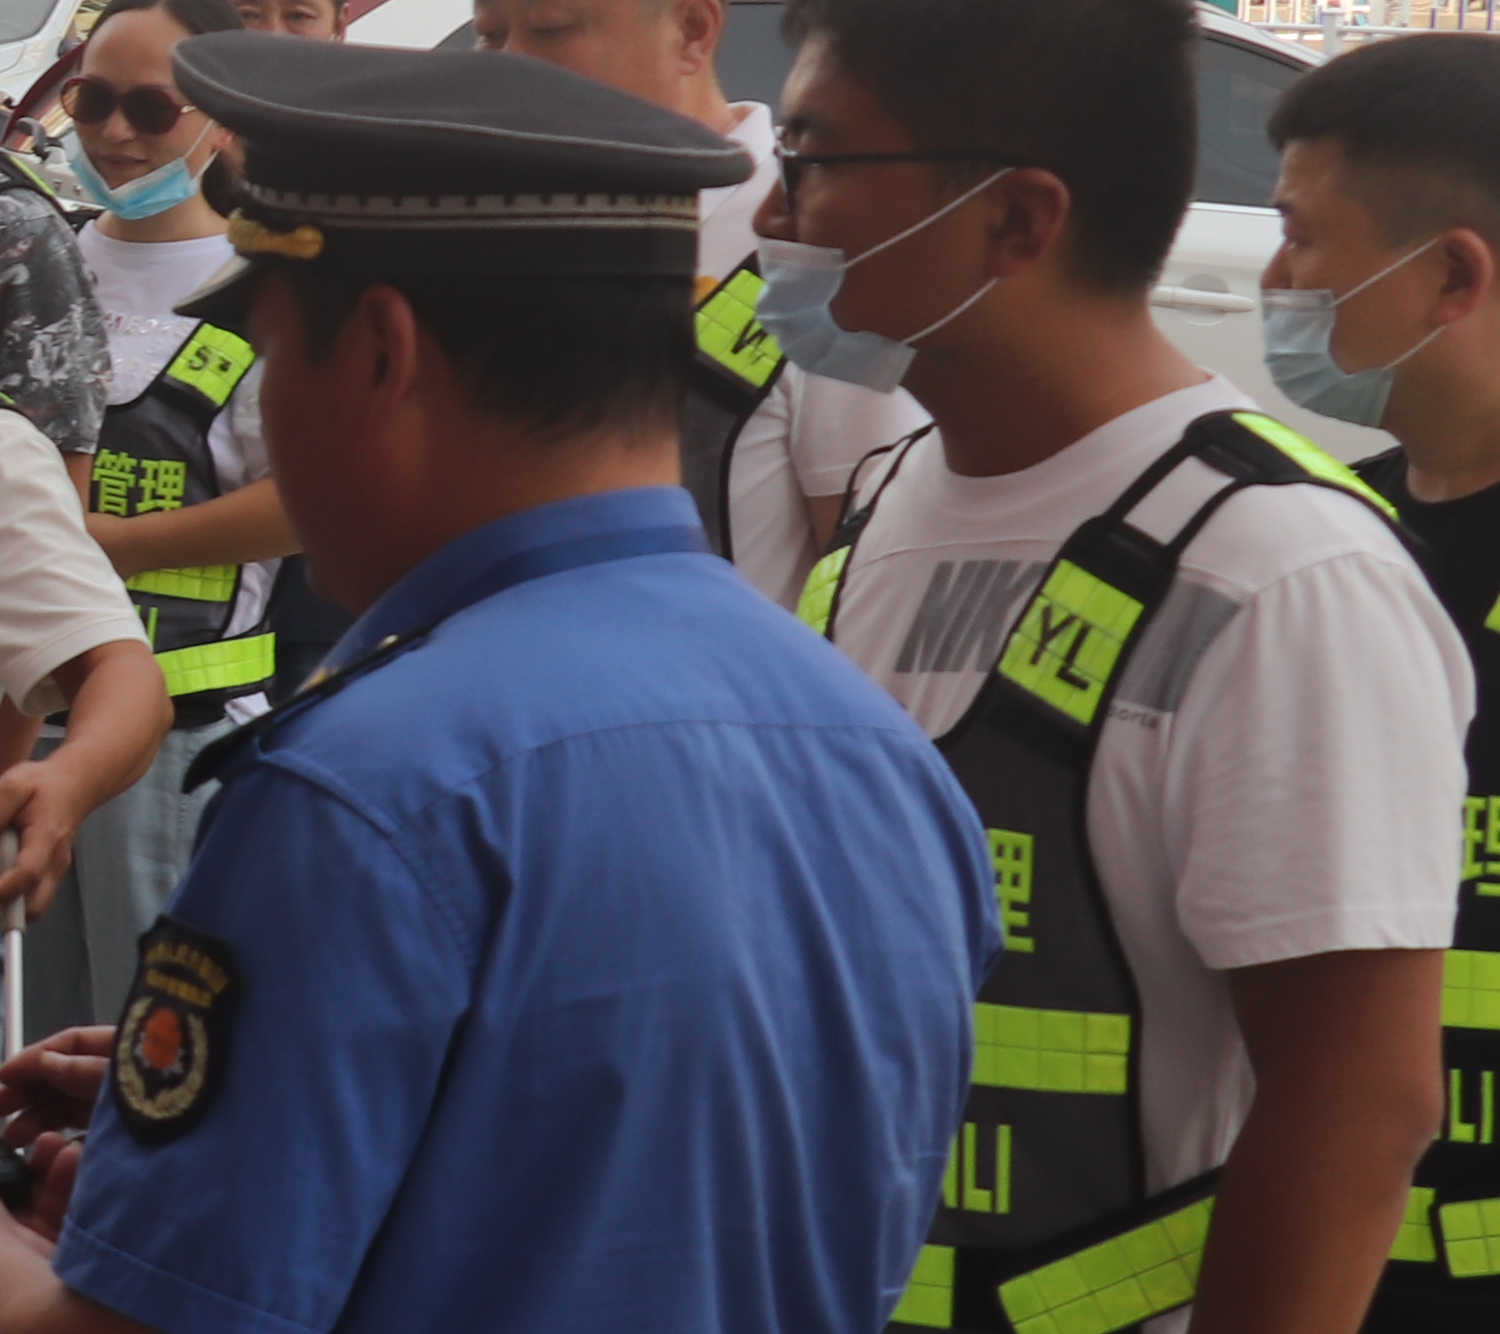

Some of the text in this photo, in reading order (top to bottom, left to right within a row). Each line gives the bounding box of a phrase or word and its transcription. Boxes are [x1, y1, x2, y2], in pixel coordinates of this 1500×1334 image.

[92, 449, 187, 517] 管理
[1028, 602, 1092, 692] YL
[1433, 1068, 1495, 1145] LI
